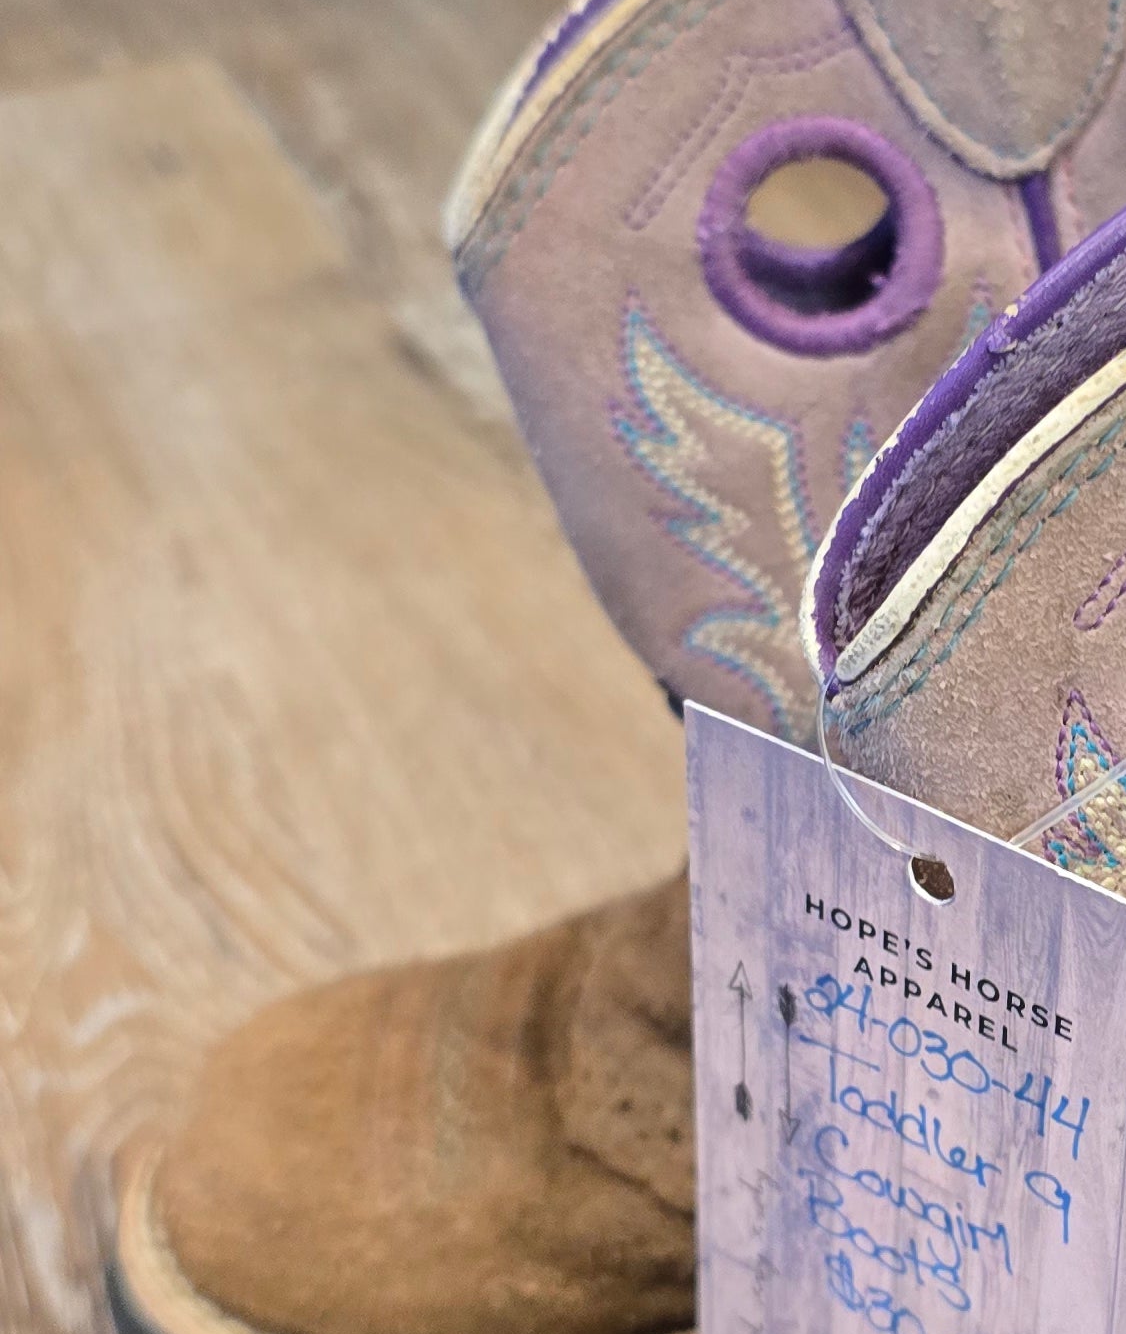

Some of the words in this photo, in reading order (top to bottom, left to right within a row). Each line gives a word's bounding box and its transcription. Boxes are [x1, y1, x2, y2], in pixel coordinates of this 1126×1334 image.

[805, 893, 933, 971] HOPE'S
[950, 963, 1073, 1043] HORSE
[853, 956, 1018, 1053] APPAREL
[798, 1033, 1002, 1188] Toddler
[803, 973, 1090, 1161] 24-030-44
[797, 1167, 971, 1312] Boots
